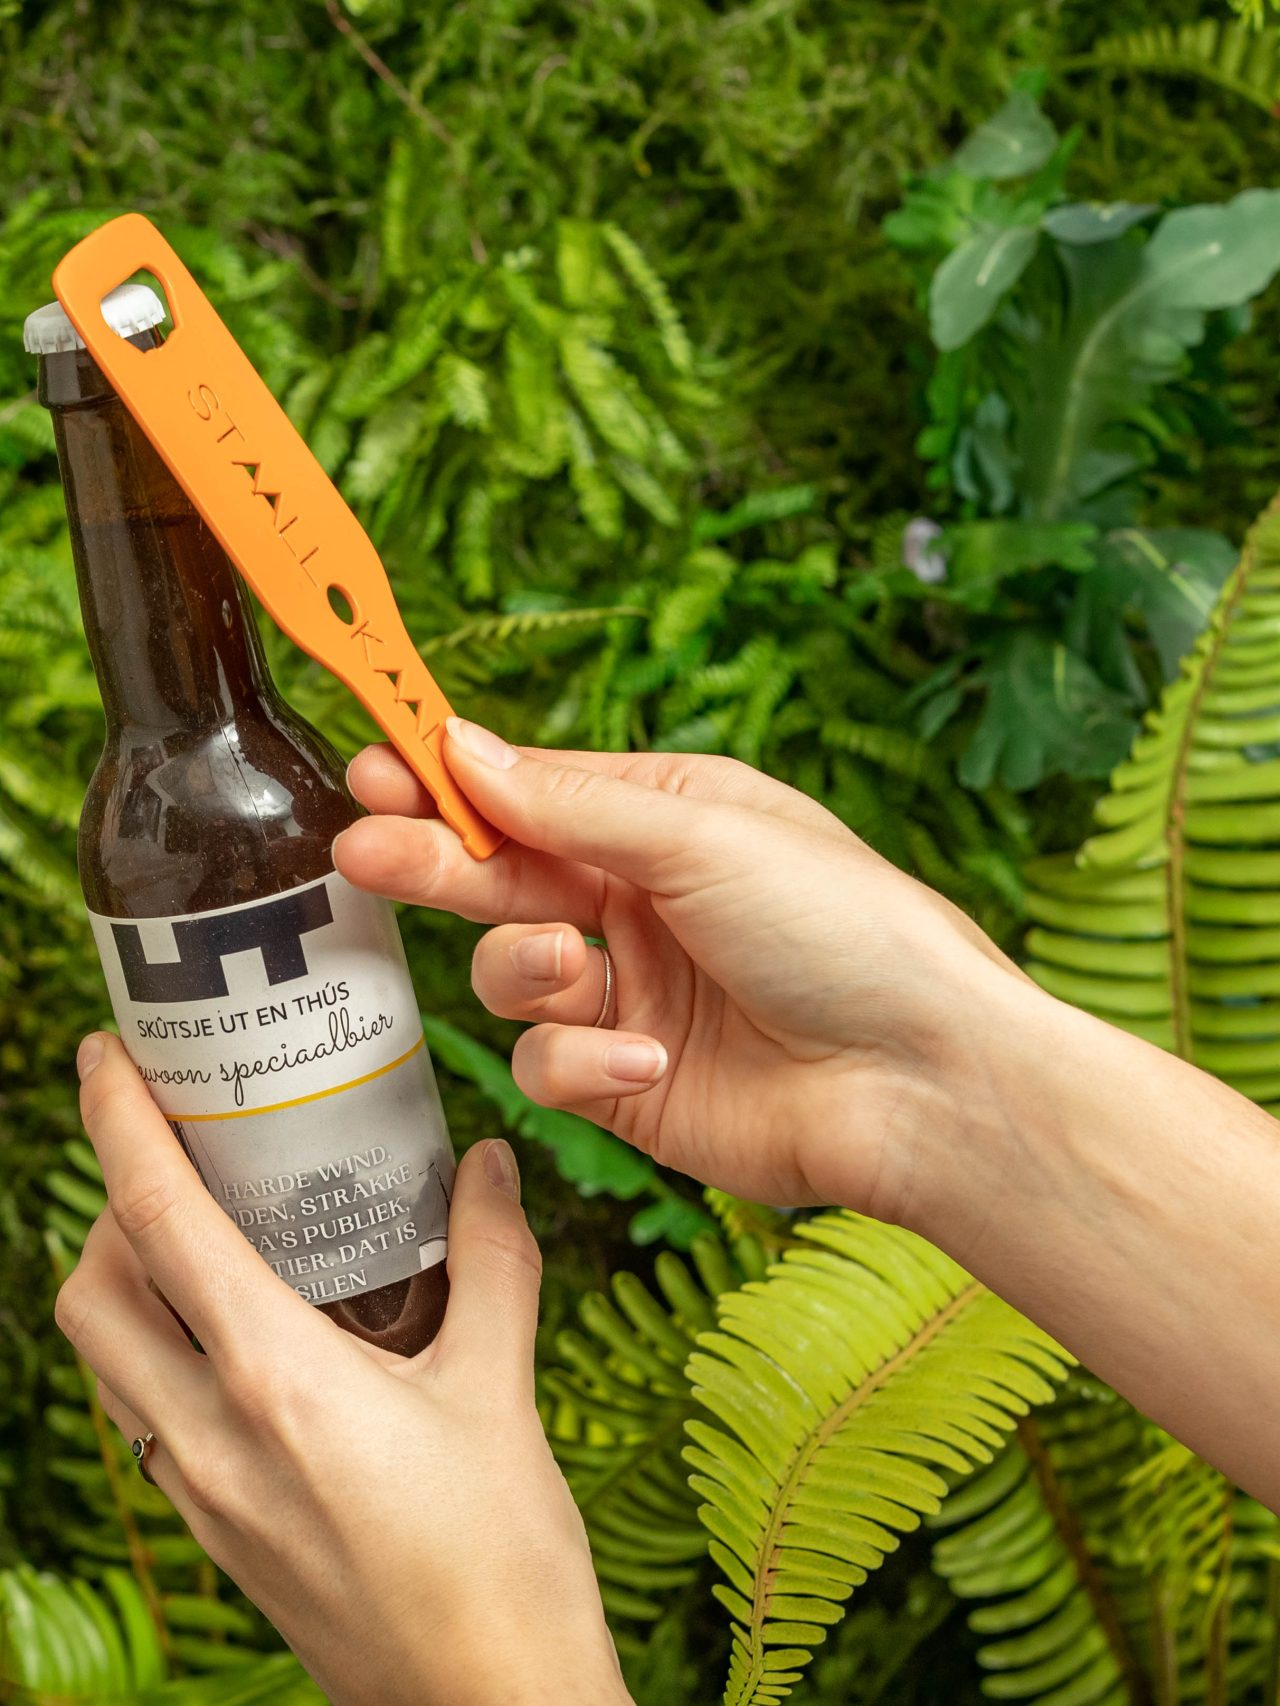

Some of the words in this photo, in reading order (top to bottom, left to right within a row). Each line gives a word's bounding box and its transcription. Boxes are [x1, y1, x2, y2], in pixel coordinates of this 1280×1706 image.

[137, 1016, 214, 1039] SKÛTSJE
[256, 1002, 288, 1026] EN
[291, 981, 350, 1016] THÚS
[220, 1006, 393, 1106] speciaalbier
[223, 1170, 311, 1200] HARDE
[317, 1146, 393, 1182] WIND,
[300, 1163, 413, 1216] STRAKKE
[302, 1196, 410, 1245] PUBLIEK,
[271, 1252, 334, 1278] TIER.
[338, 1231, 391, 1264] DAT
[396, 1221, 418, 1245] IS
[295, 1269, 367, 1302] SILEN
